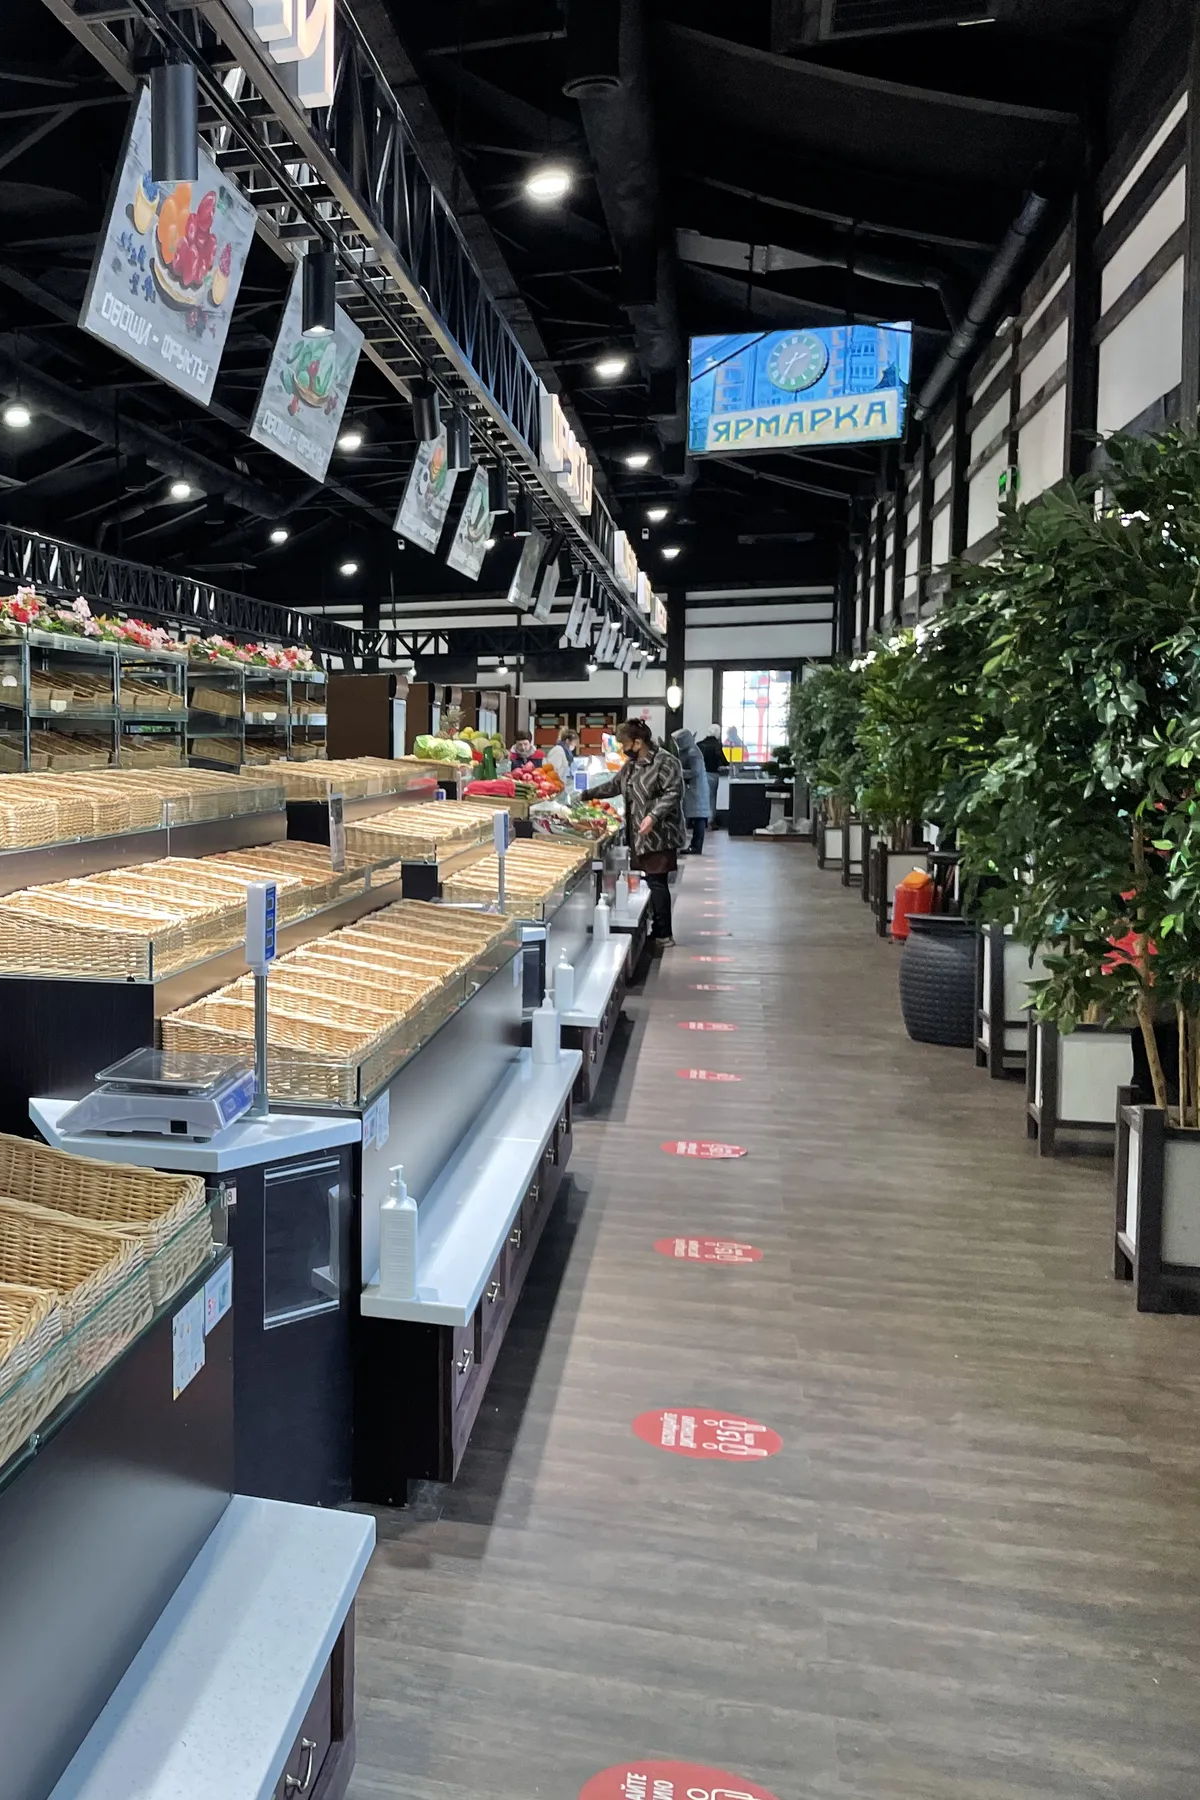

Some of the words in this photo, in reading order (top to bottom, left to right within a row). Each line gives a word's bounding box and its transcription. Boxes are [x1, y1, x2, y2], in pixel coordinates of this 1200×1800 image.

[101, 292, 152, 346] ОВОЩИ
[161, 340, 209, 384] ФРУКТЫ
[712, 400, 887, 444] ЯРМАРКА
